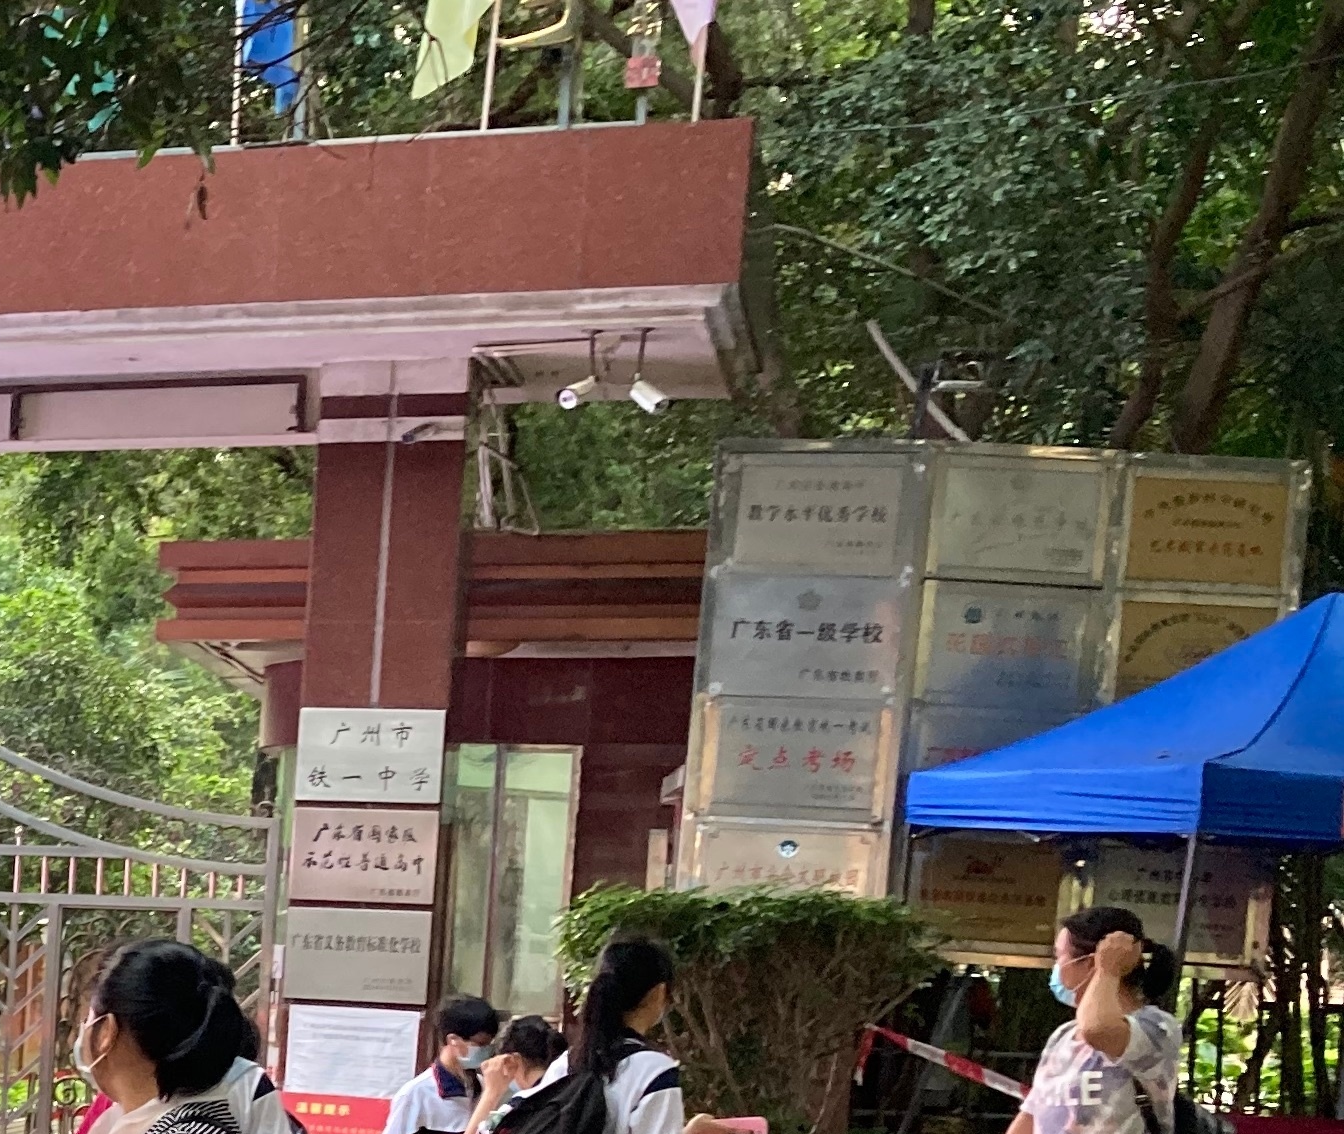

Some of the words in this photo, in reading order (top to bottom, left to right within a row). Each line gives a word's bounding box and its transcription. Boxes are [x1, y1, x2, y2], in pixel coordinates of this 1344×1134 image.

[730, 618, 885, 643] 广东省一级学校
[329, 722, 414, 749] 广州市
[737, 744, 857, 773] 定点考场
[307, 765, 431, 791] 铁一中学
[313, 823, 418, 843] 广东省国家级
[302, 850, 425, 875] 示范性普通高中
